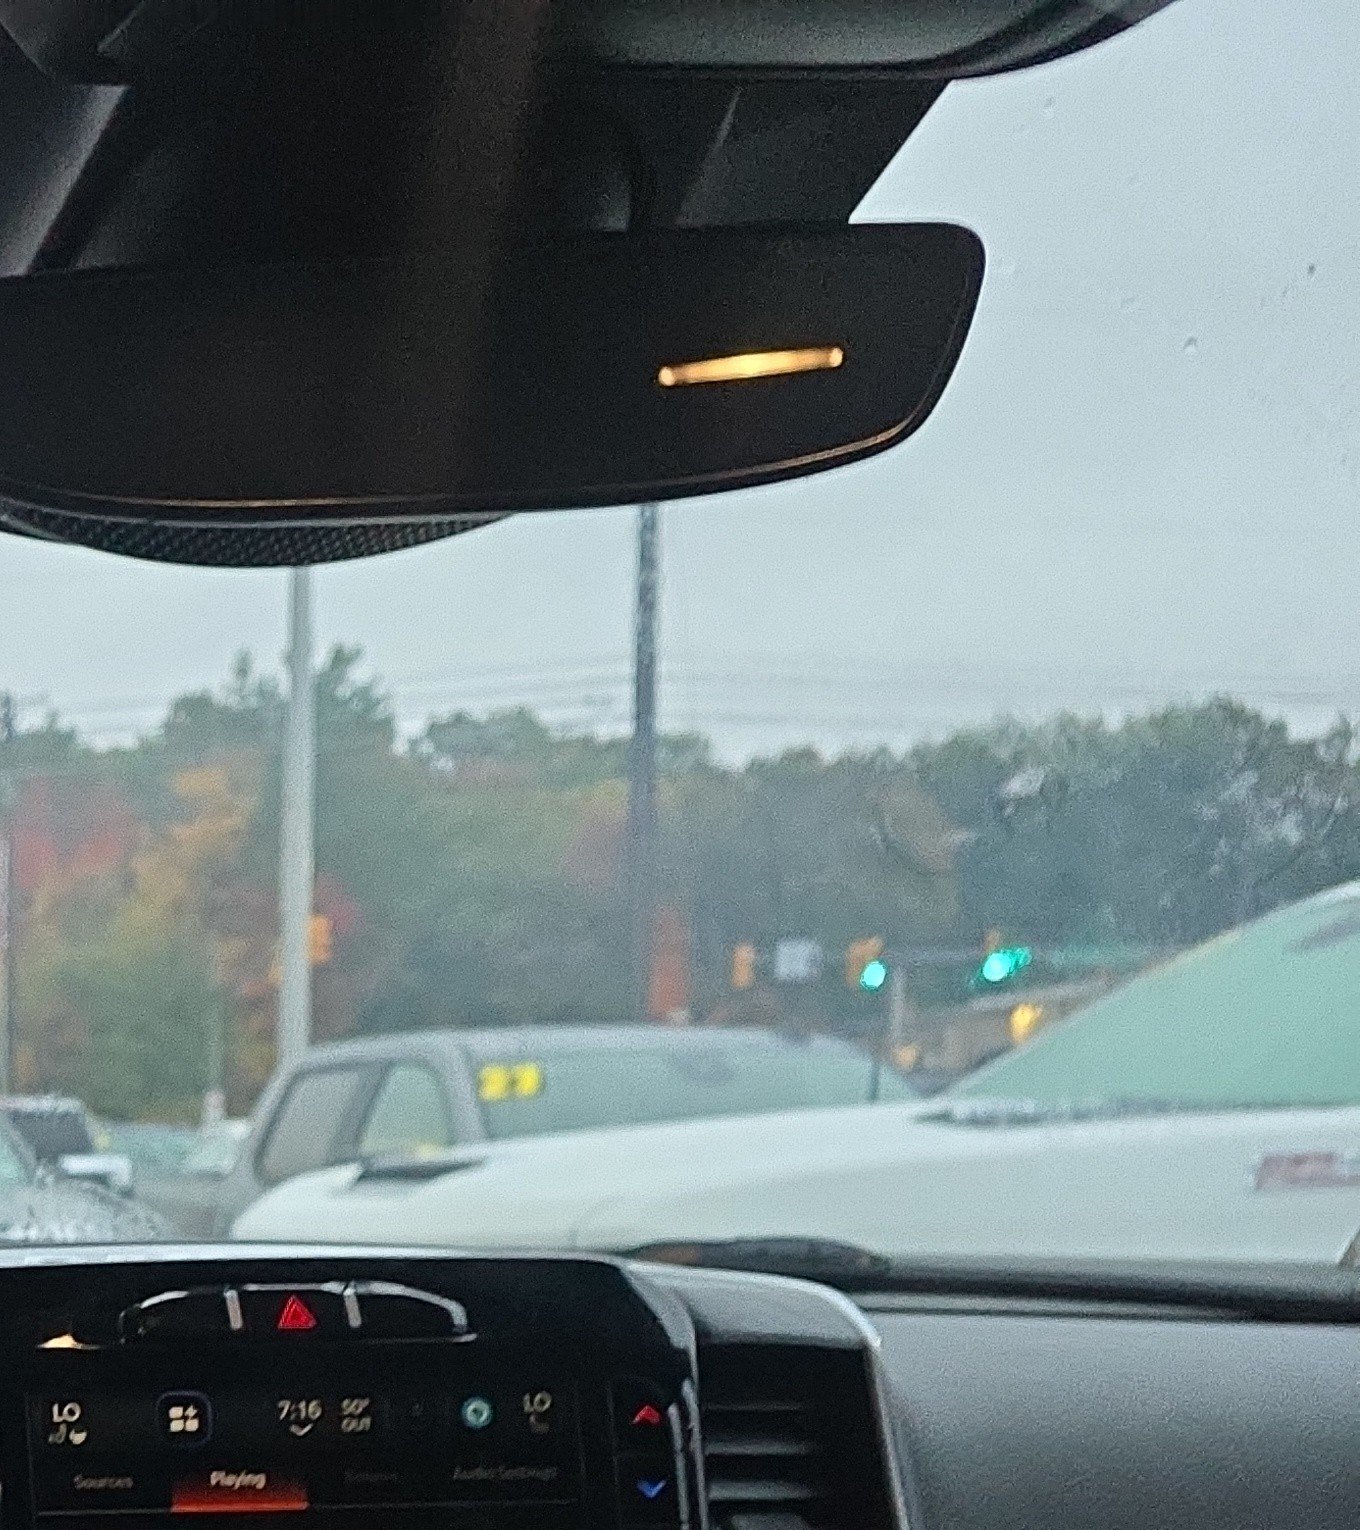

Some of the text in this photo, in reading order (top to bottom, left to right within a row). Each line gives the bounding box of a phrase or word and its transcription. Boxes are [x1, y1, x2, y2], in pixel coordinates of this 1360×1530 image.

[52, 1402, 81, 1422] LO
[278, 1399, 322, 1420] 7:16
[210, 1471, 267, 1489] Playing
